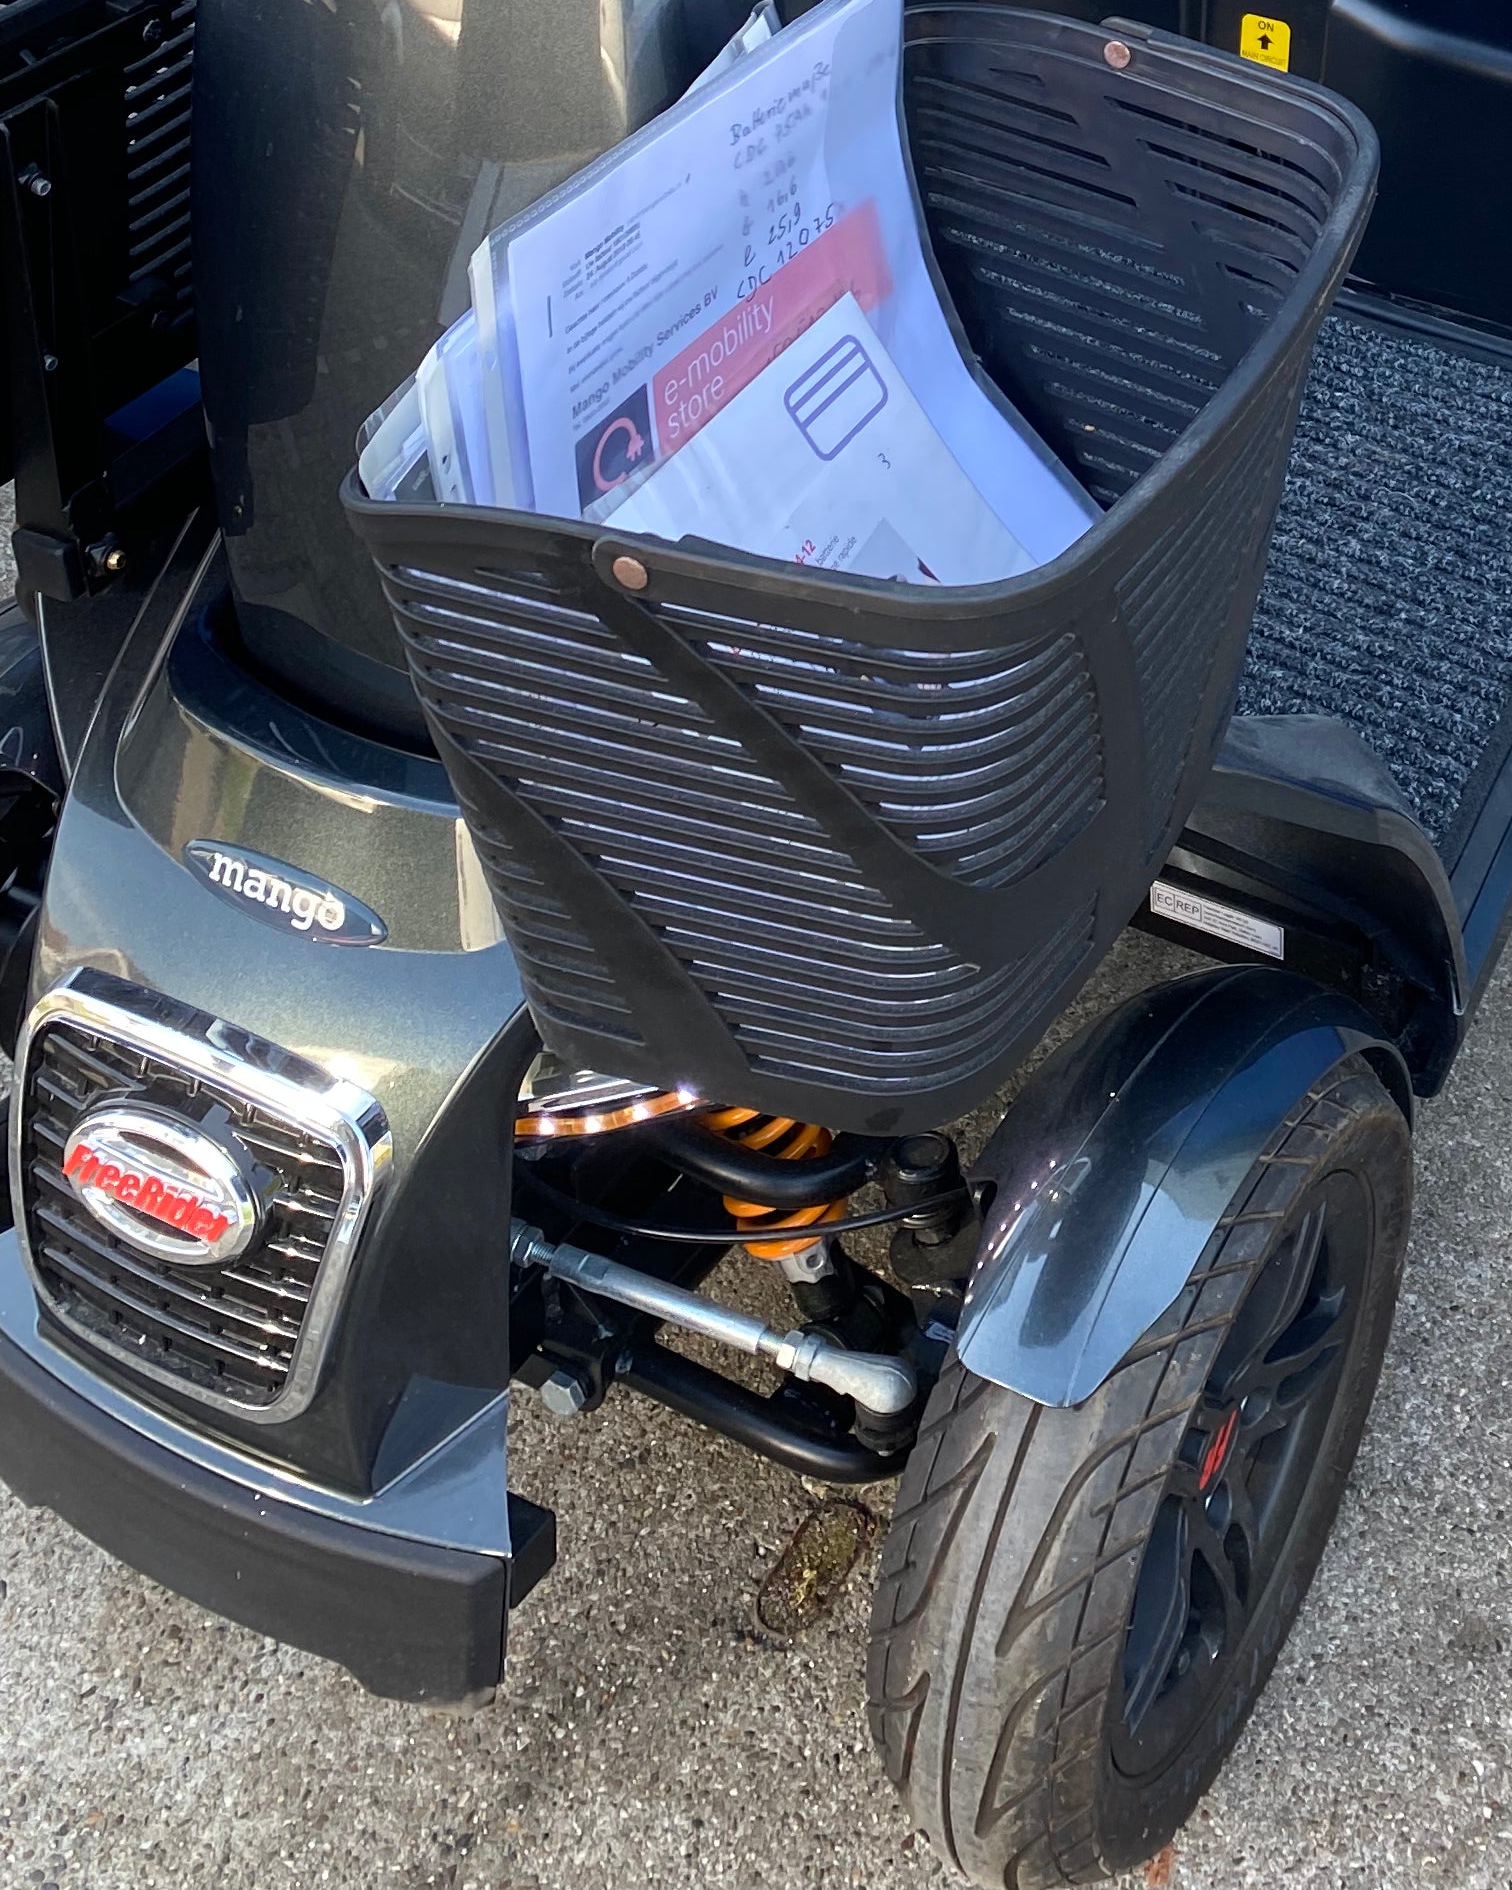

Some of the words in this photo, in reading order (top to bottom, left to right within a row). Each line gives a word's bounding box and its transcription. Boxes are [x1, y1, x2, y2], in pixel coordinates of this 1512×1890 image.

[1258, 21, 1274, 32] ON
[571, 381, 610, 419] Mango
[611, 342, 654, 386] Mobility
[656, 302, 702, 347] Services
[703, 284, 719, 308] BV
[664, 294, 775, 406] e-mobility
[667, 374, 727, 439] store
[838, 535, 858, 563] rapide
[208, 852, 346, 932] mango
[1156, 891, 1174, 907] EC
[1175, 899, 1200, 915] REP
[61, 1143, 240, 1243] FreeRider
